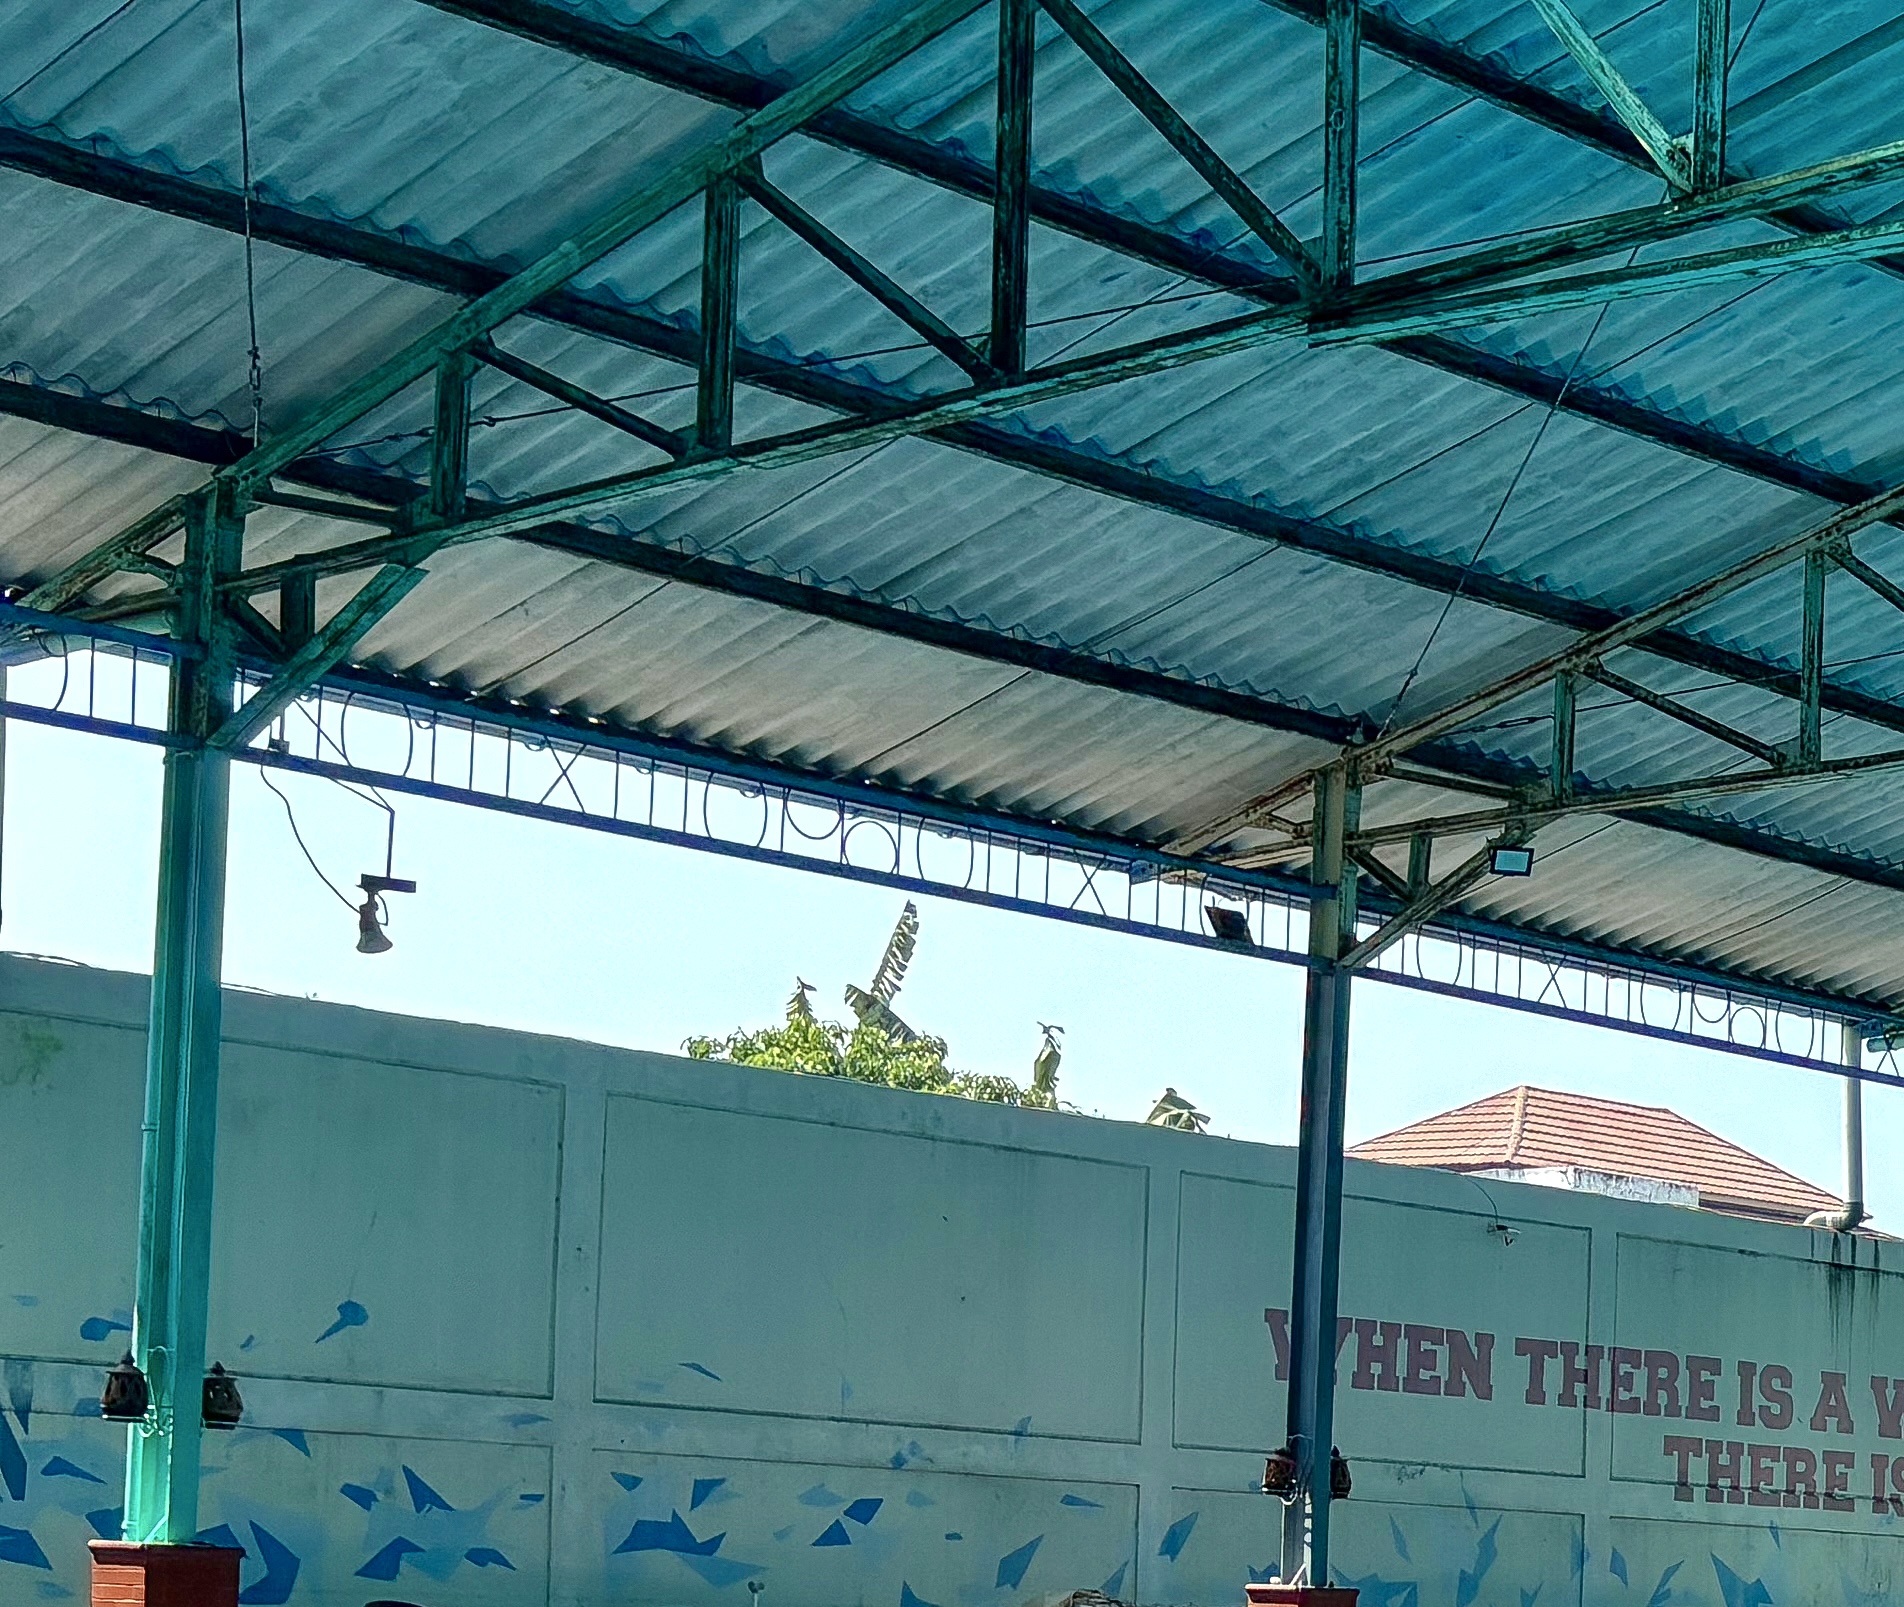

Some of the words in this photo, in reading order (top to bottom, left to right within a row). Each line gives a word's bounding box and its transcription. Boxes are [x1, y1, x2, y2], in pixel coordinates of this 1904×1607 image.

[1514, 1337, 1721, 1424] THERE
[1736, 1360, 1793, 1430] IS
[1810, 1371, 1854, 1435] A
[1663, 1435, 1856, 1512] THERE
